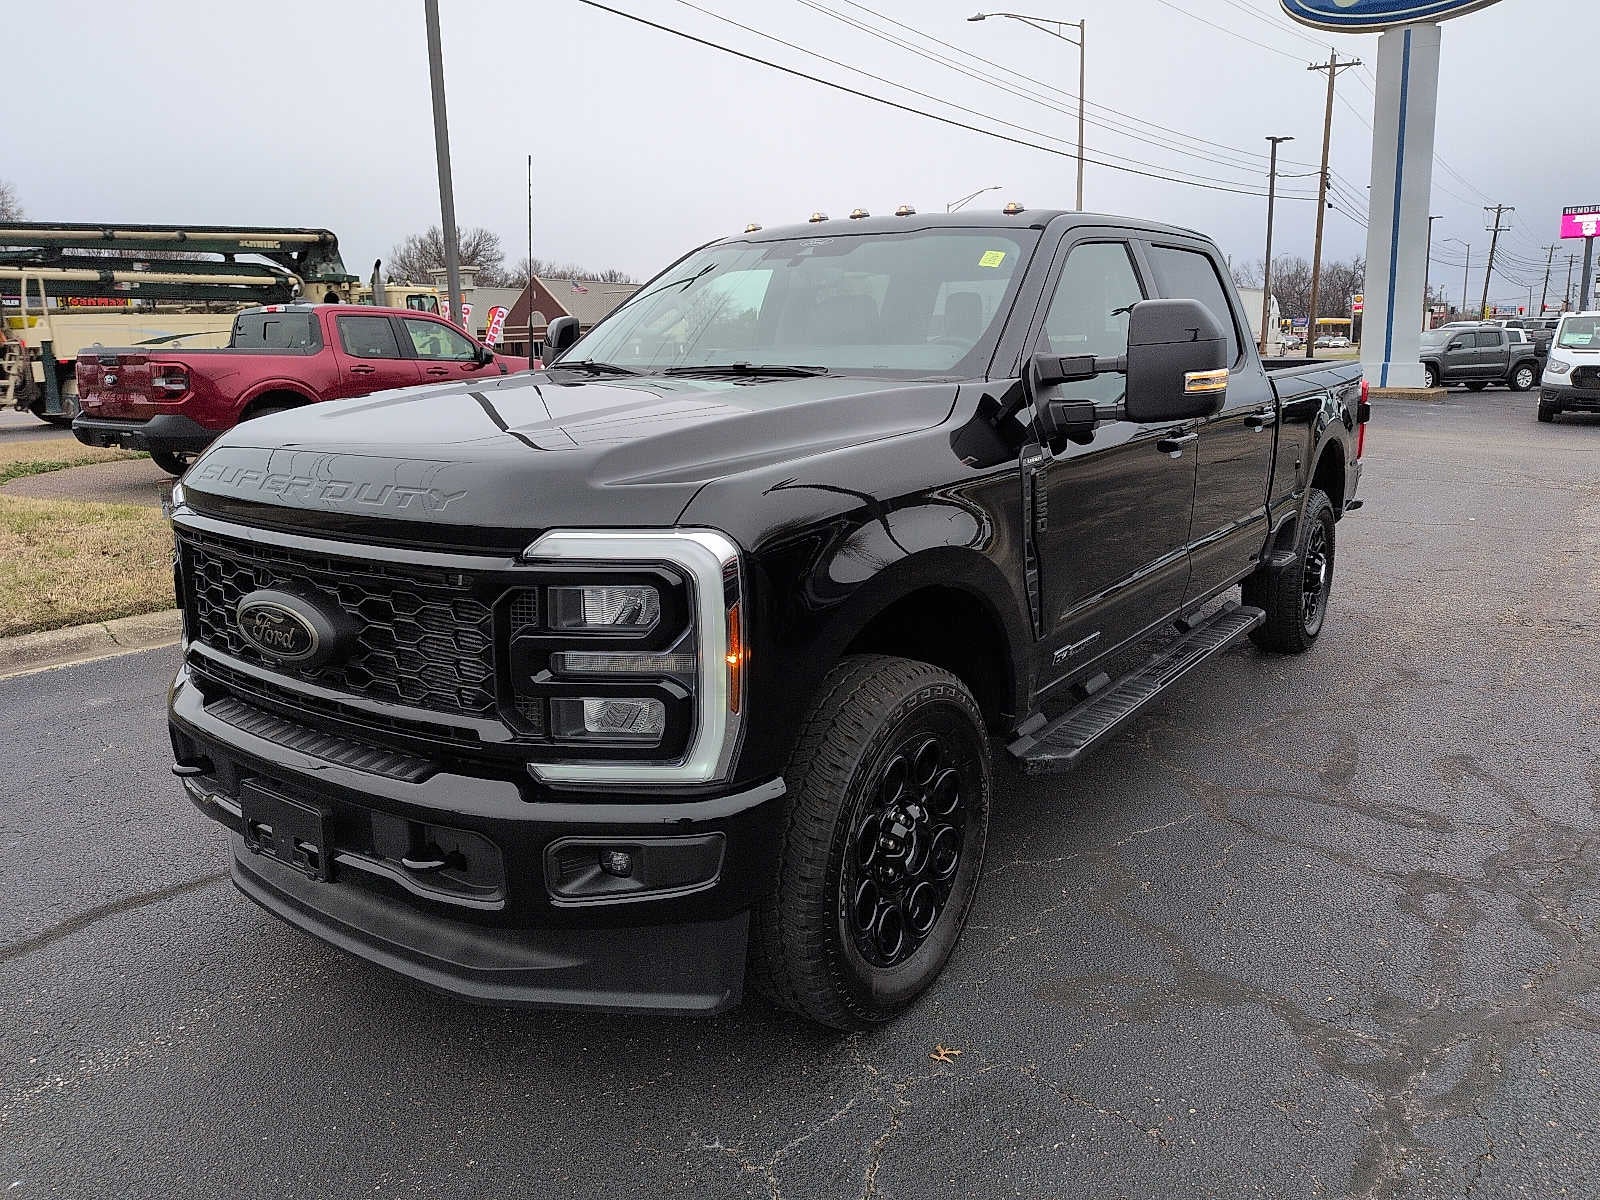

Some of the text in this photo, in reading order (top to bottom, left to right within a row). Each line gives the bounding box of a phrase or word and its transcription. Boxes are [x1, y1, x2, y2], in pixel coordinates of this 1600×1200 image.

[198, 463, 469, 512] SUPER DUTY
[253, 611, 296, 649] Ford
